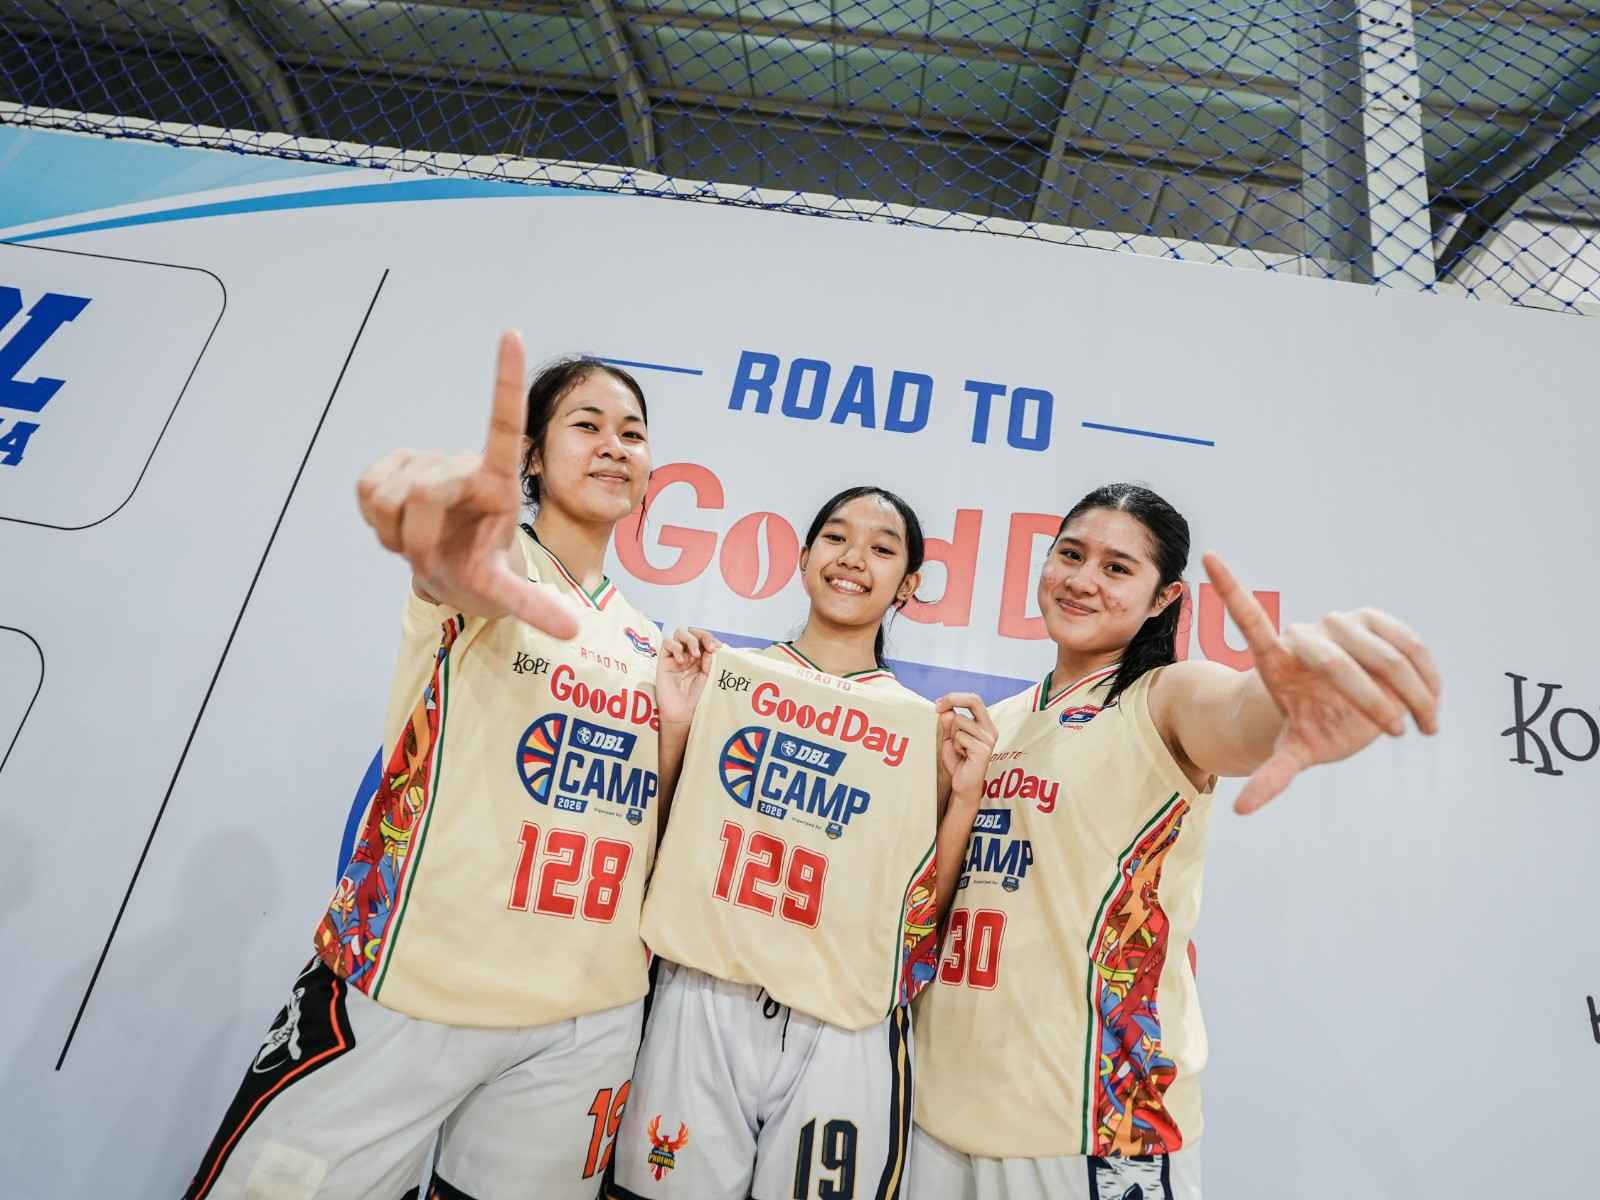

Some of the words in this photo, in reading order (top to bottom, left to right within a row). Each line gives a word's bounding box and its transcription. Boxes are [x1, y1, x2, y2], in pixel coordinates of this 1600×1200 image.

[728, 350, 934, 434] ROAD
[964, 379, 1054, 452] TO
[615, 462, 983, 627] God
[614, 659, 628, 674] TO
[836, 679, 852, 691] TO
[590, 731, 624, 753] DBL
[795, 745, 830, 769] DBL
[557, 797, 582, 811] 2026
[559, 751, 658, 809] CAMP
[760, 761, 871, 826] CAMP
[760, 802, 783, 817] 2026
[973, 814, 1002, 829] DBL
[507, 820, 634, 924] 128
[711, 819, 830, 930] 129
[961, 836, 1034, 878] AMP
[582, 1078, 631, 1180] 19
[793, 1116, 858, 1200] 19
